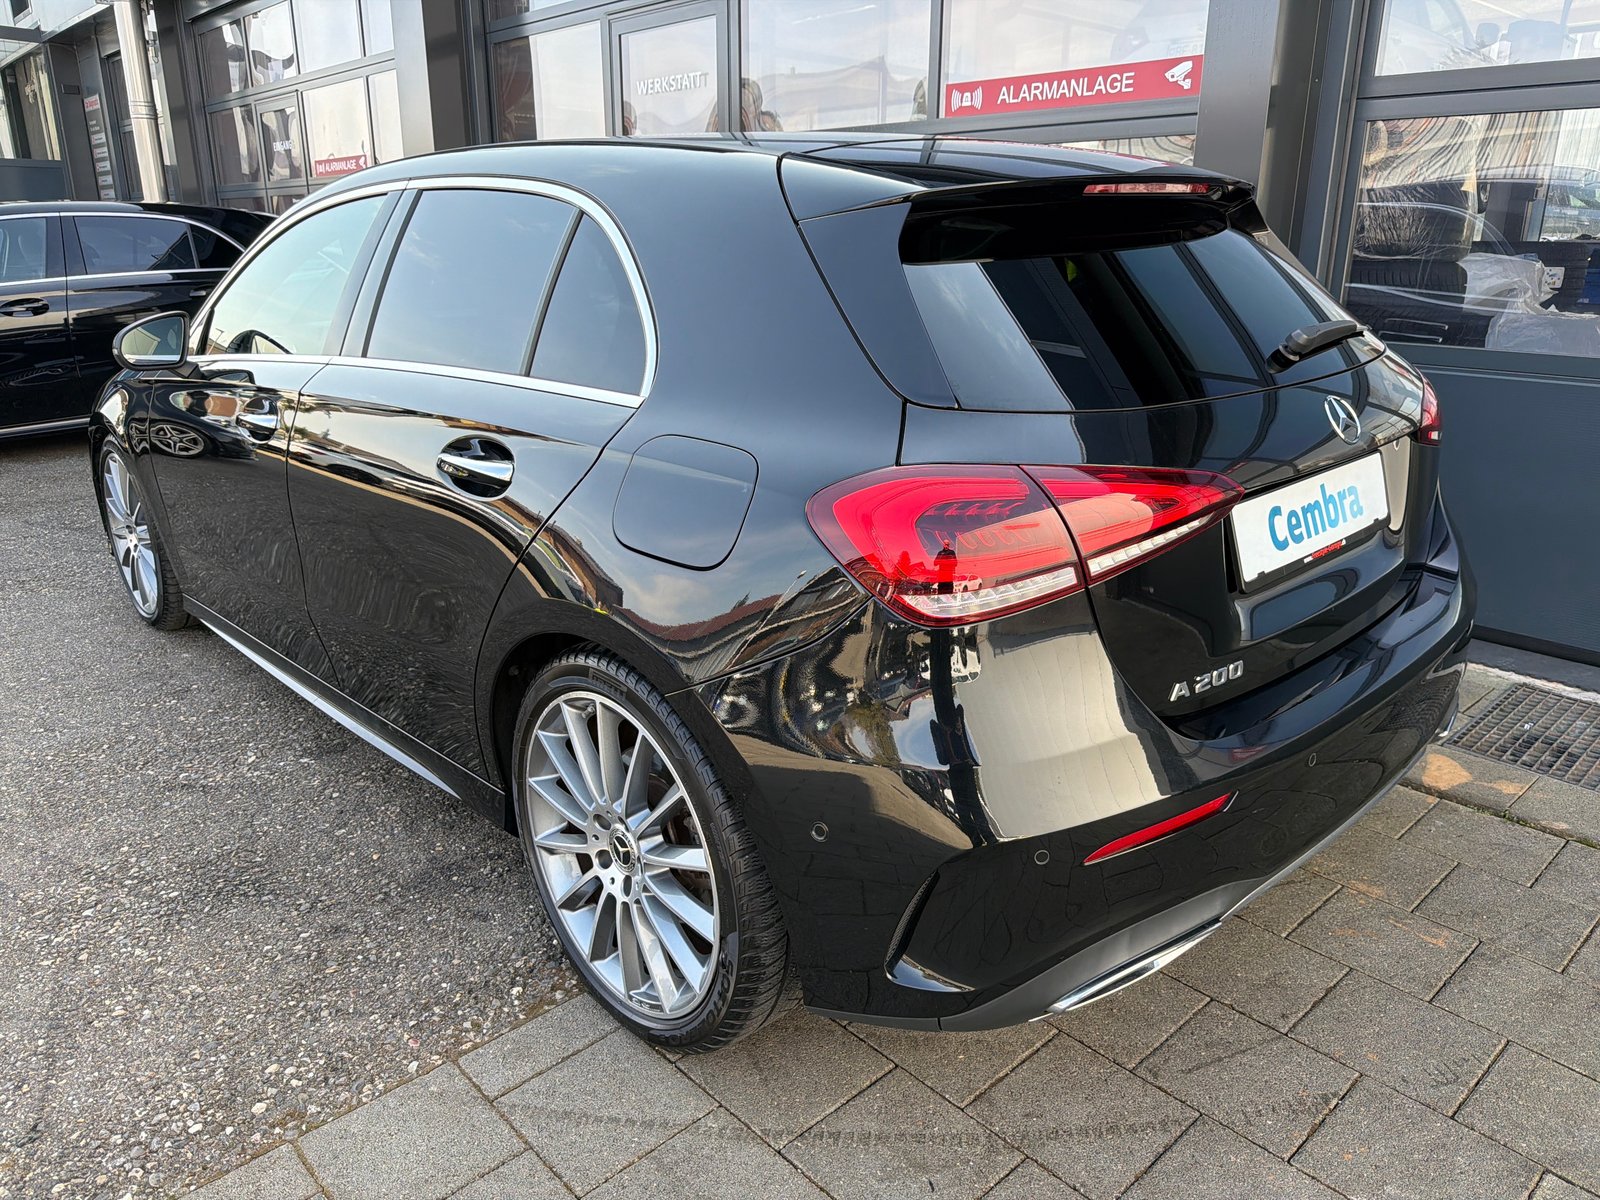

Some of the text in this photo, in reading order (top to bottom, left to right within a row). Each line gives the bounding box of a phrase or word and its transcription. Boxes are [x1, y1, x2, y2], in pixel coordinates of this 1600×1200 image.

[636, 71, 702, 95] WERKSTATT
[997, 72, 1135, 104] ALARMANLAGE
[325, 160, 356, 172] ALARMANLAGE
[1268, 483, 1363, 551] Cembra
[1168, 660, 1244, 702] A 200
